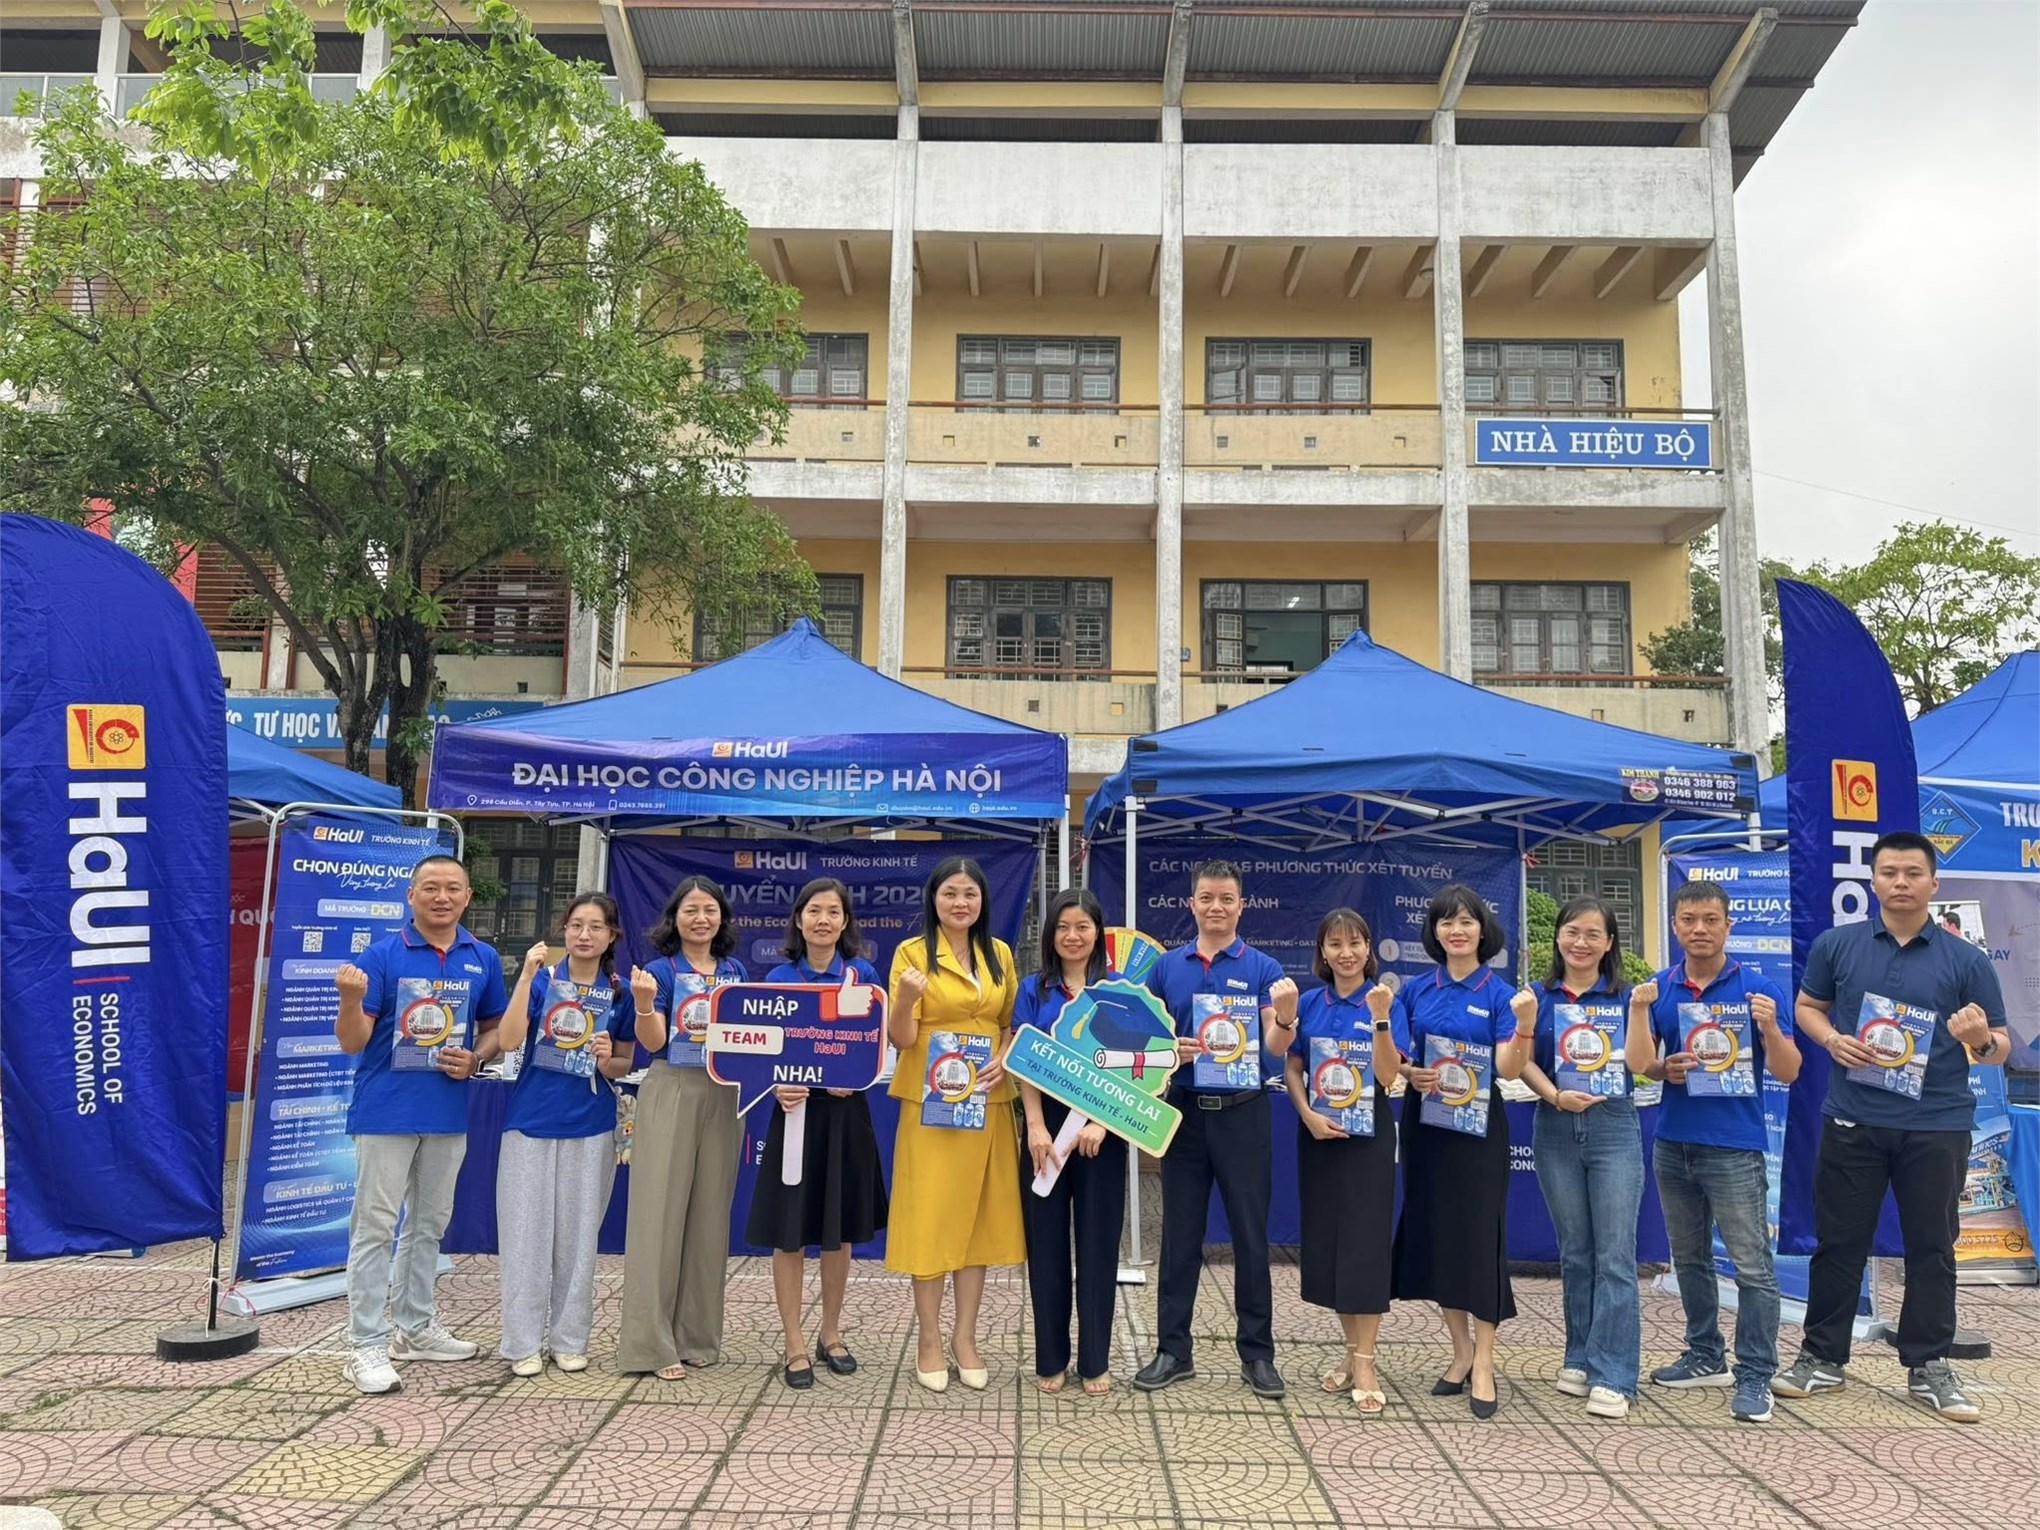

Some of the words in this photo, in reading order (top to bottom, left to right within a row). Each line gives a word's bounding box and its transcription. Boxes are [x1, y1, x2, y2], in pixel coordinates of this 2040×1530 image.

[1491, 424, 1558, 453] NHÀ
[1569, 426, 1644, 459] HIỆU
[1655, 428, 1696, 462] BỘ
[281, 712, 321, 743] HỌC
[735, 741, 788, 758] HaUI
[512, 763, 569, 793] ĐẠI
[577, 764, 651, 794] HỌC
[657, 761, 756, 790] CÔNG
[764, 763, 885, 798] NGHIỆP
[892, 762, 937, 791] HÀ
[946, 763, 1001, 799] NỘI
[1664, 776, 1690, 786] 0346
[1665, 788, 1691, 797] 0346
[1694, 790, 1714, 800] 902
[1716, 792, 1736, 802] 012
[328, 827, 364, 844] HaUI
[402, 837, 422, 846] KINH
[293, 858, 338, 876] CHỌN
[341, 859, 385, 877] ĐÚNG
[755, 851, 807, 870] HaUI
[820, 855, 870, 868] TRƯỜNG
[872, 857, 900, 867] KINH
[902, 853, 918, 867] TẾ
[1149, 858, 1180, 873] CÁC
[1255, 859, 1322, 874] PHƯƠNG
[1324, 859, 1365, 873] THỨC
[1368, 860, 1396, 874] XÉT
[1399, 861, 1453, 880] TUYỂN
[68, 782, 150, 967] HaUI
[1703, 867, 1739, 881] HaUI
[1747, 869, 1783, 878] TRƯỜNG
[719, 874, 796, 905] UYỂN
[1148, 894, 1176, 908] CÁC
[1748, 897, 1782, 913] LỰA
[738, 916, 762, 927] the
[880, 916, 903, 928] the
[443, 981, 470, 991] HaUI
[588, 987, 613, 1000] HaUI
[743, 995, 799, 1020] NHẬP
[1233, 996, 1258, 1007] HaUI
[1722, 1004, 1748, 1014] HaUI
[1596, 1006, 1622, 1017] HaUI
[1907, 1006, 1935, 1023] HaUI
[100, 993, 121, 1074] SCHOOL
[722, 1030, 767, 1045] TEAM
[784, 1025, 832, 1039] TRƯỜNG
[834, 1029, 863, 1042] KINH
[863, 1027, 880, 1043] TẾ
[968, 1036, 991, 1048] HaUI
[72, 995, 97, 1115] ECONOMICS
[813, 1042, 847, 1055] HaUI
[1465, 1043, 1490, 1058] HaUI
[773, 1064, 823, 1083] NHA!
[1030, 1039, 1057, 1061] KẾT
[1056, 1054, 1085, 1078] NỐI
[1085, 1069, 1137, 1107] TƯƠNG
[1136, 1100, 1162, 1121] LAI
[103, 1078, 123, 1104] OF
[1027, 1059, 1042, 1073] TẠI
[1082, 1090, 1107, 1110] KINH
[1107, 1103, 1122, 1117] TẾ
[1124, 1114, 1149, 1134] HaUI
